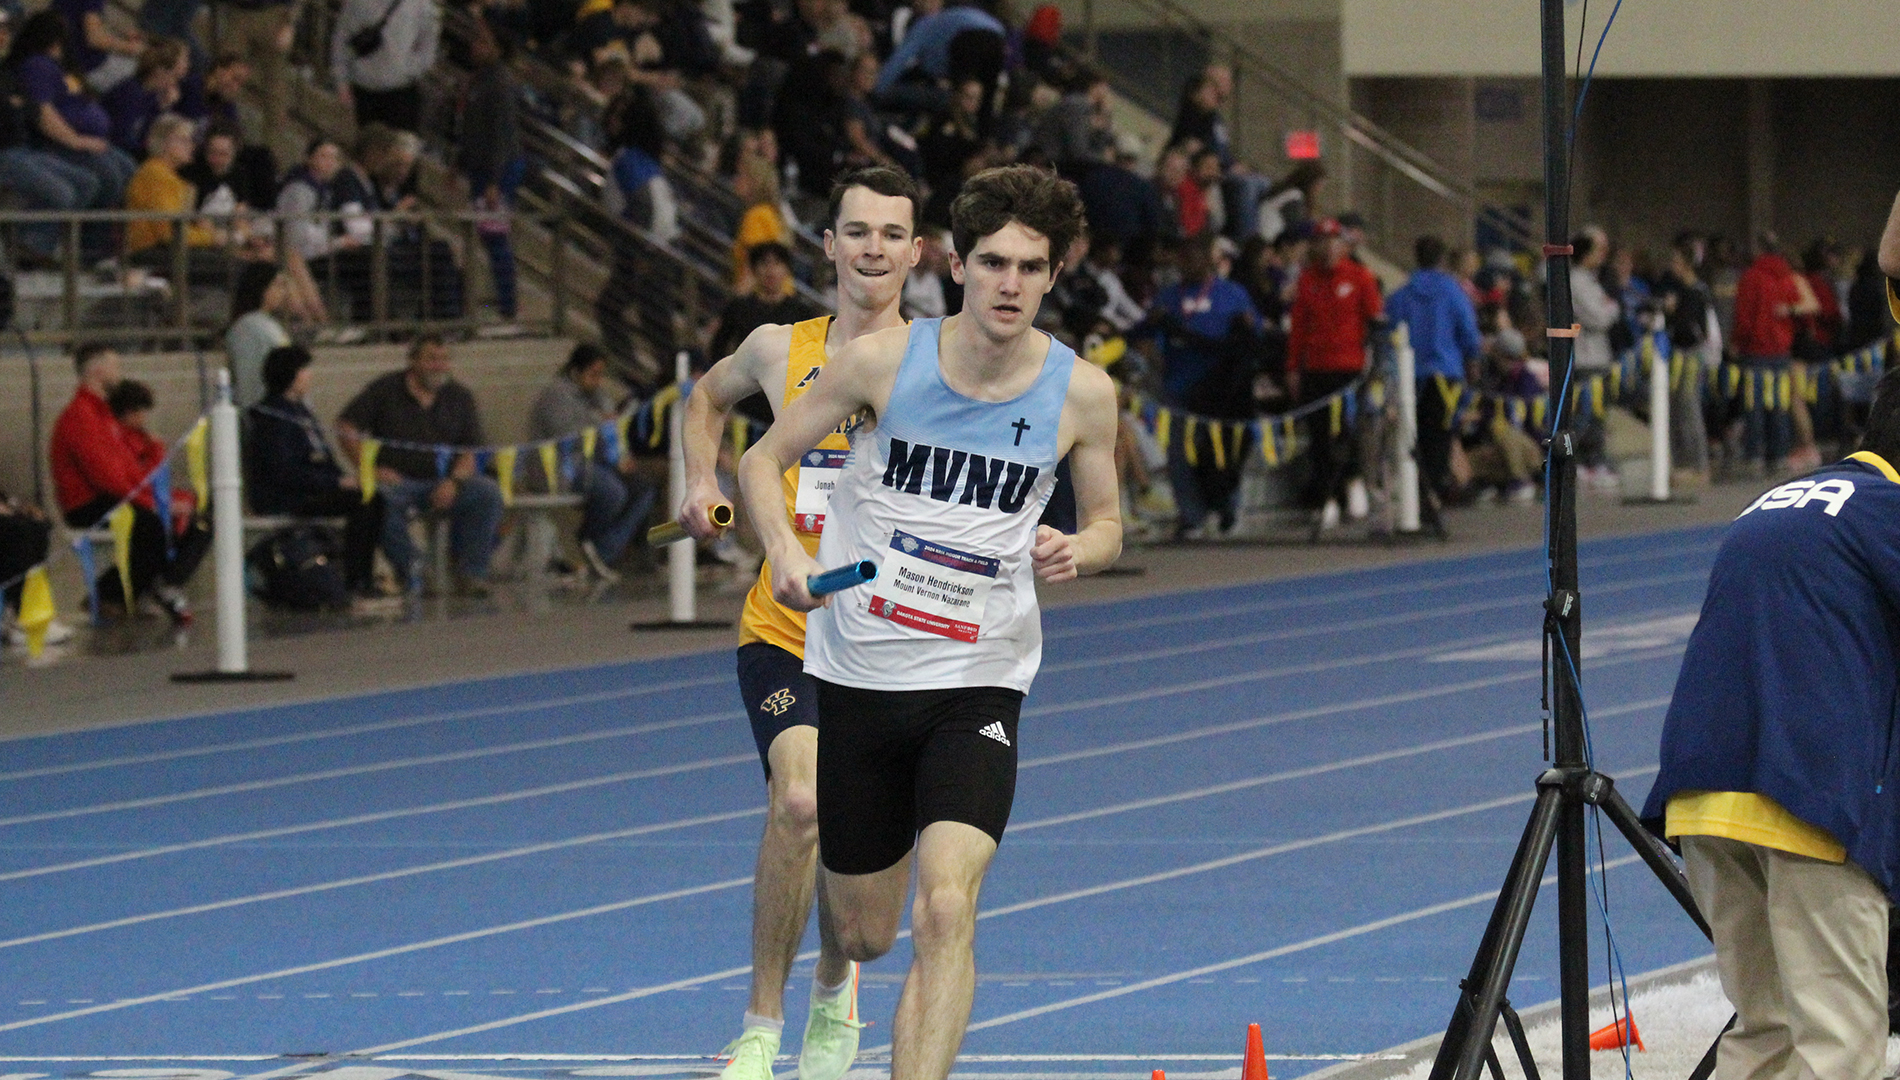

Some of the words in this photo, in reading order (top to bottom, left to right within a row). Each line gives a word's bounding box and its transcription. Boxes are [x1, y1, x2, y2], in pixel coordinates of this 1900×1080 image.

[882, 437, 1040, 514] MVNU
[814, 480, 836, 490] Jonah
[961, 555, 974, 563] TRACK
[898, 566, 925, 584] Mason
[927, 575, 974, 596] Hendrickson
[893, 579, 915, 593] Mount
[916, 586, 940, 600] Vernon
[941, 594, 971, 608] Nazarene
[896, 610, 913, 619] DAKOTA
[913, 615, 927, 624] STATE
[926, 620, 950, 629] UNIVERSITY
[954, 624, 978, 632] SANFORD
[979, 729, 1011, 747] adidas
